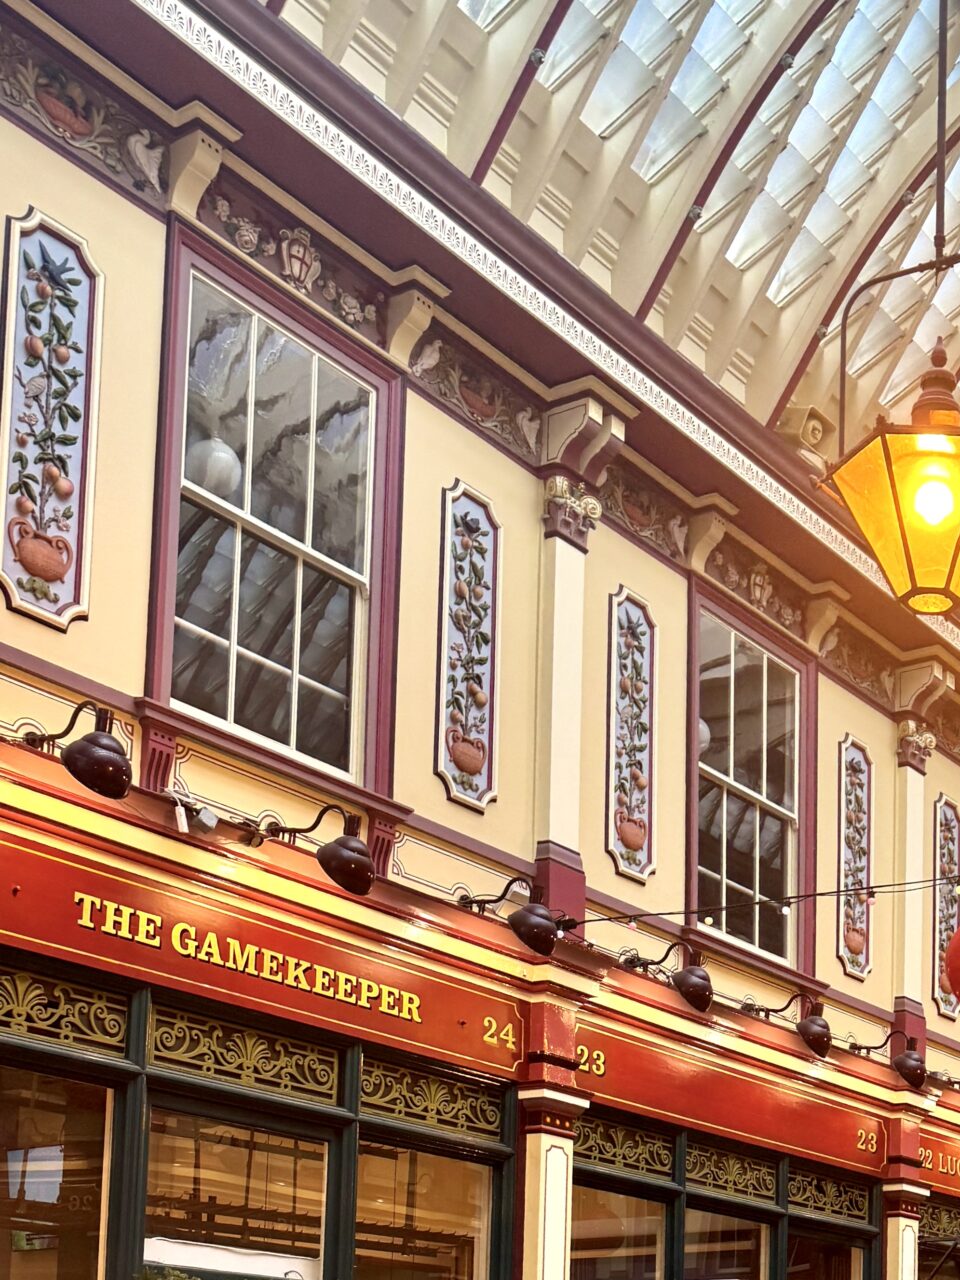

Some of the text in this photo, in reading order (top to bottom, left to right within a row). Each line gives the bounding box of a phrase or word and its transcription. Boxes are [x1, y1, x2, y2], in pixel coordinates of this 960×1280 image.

[74, 891, 422, 1023] THE GAMEKEEPER
[482, 1016, 516, 1051] 24
[576, 1045, 606, 1076] 23
[857, 1129, 878, 1153] 23
[919, 1147, 933, 1169] 22
